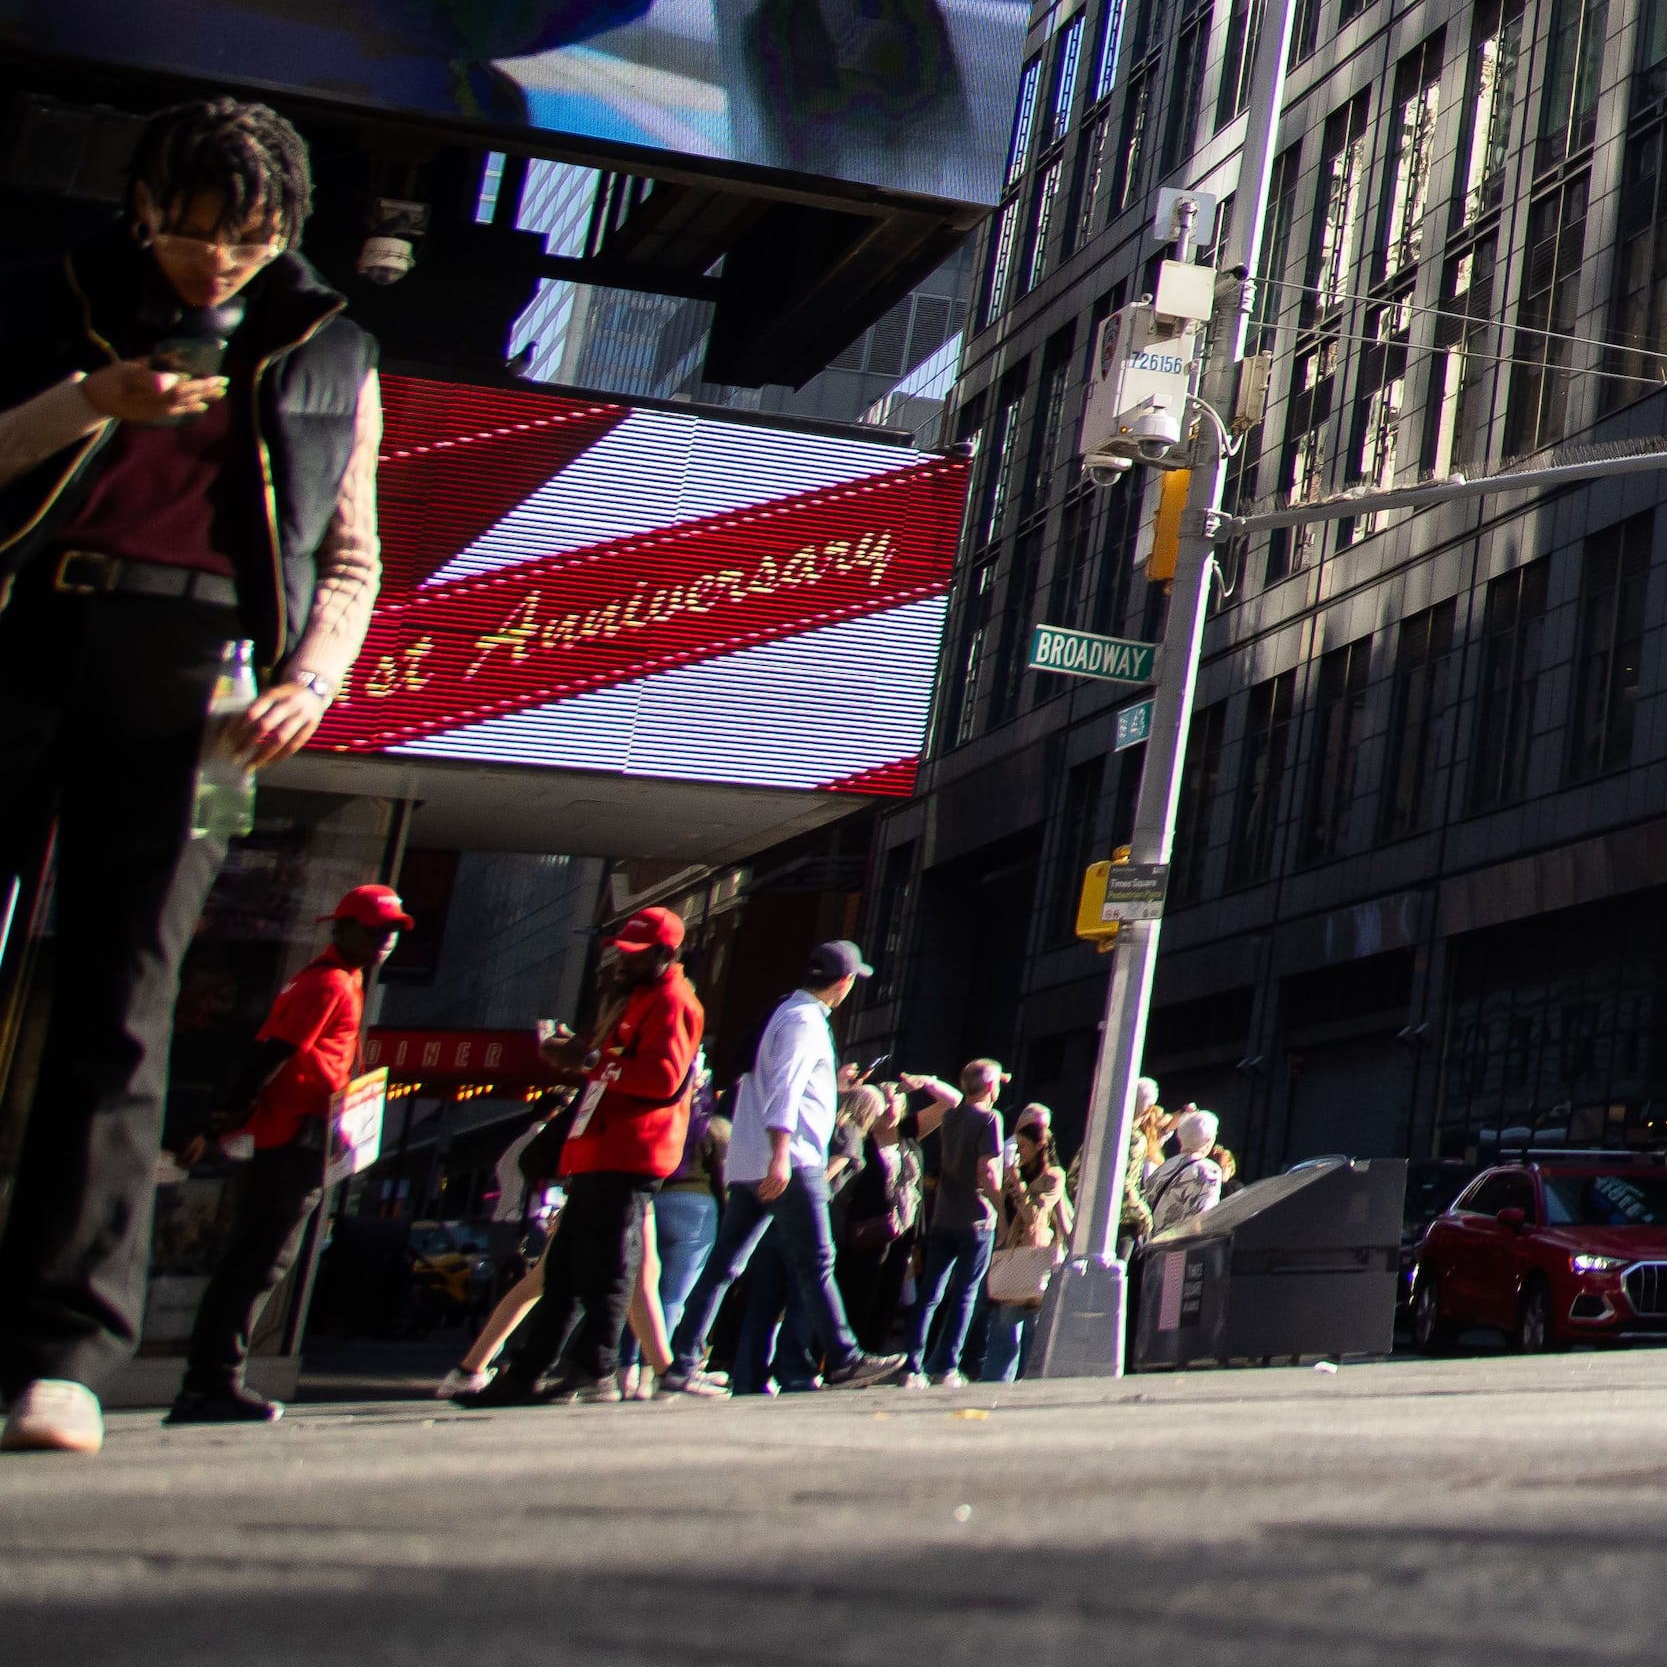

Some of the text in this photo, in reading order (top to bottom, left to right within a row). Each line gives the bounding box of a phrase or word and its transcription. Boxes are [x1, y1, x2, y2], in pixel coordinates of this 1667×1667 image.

[1131, 352, 1183, 374] 726156
[464, 529, 895, 680] Anniversary
[1035, 631, 1148, 678] BROADWAY
